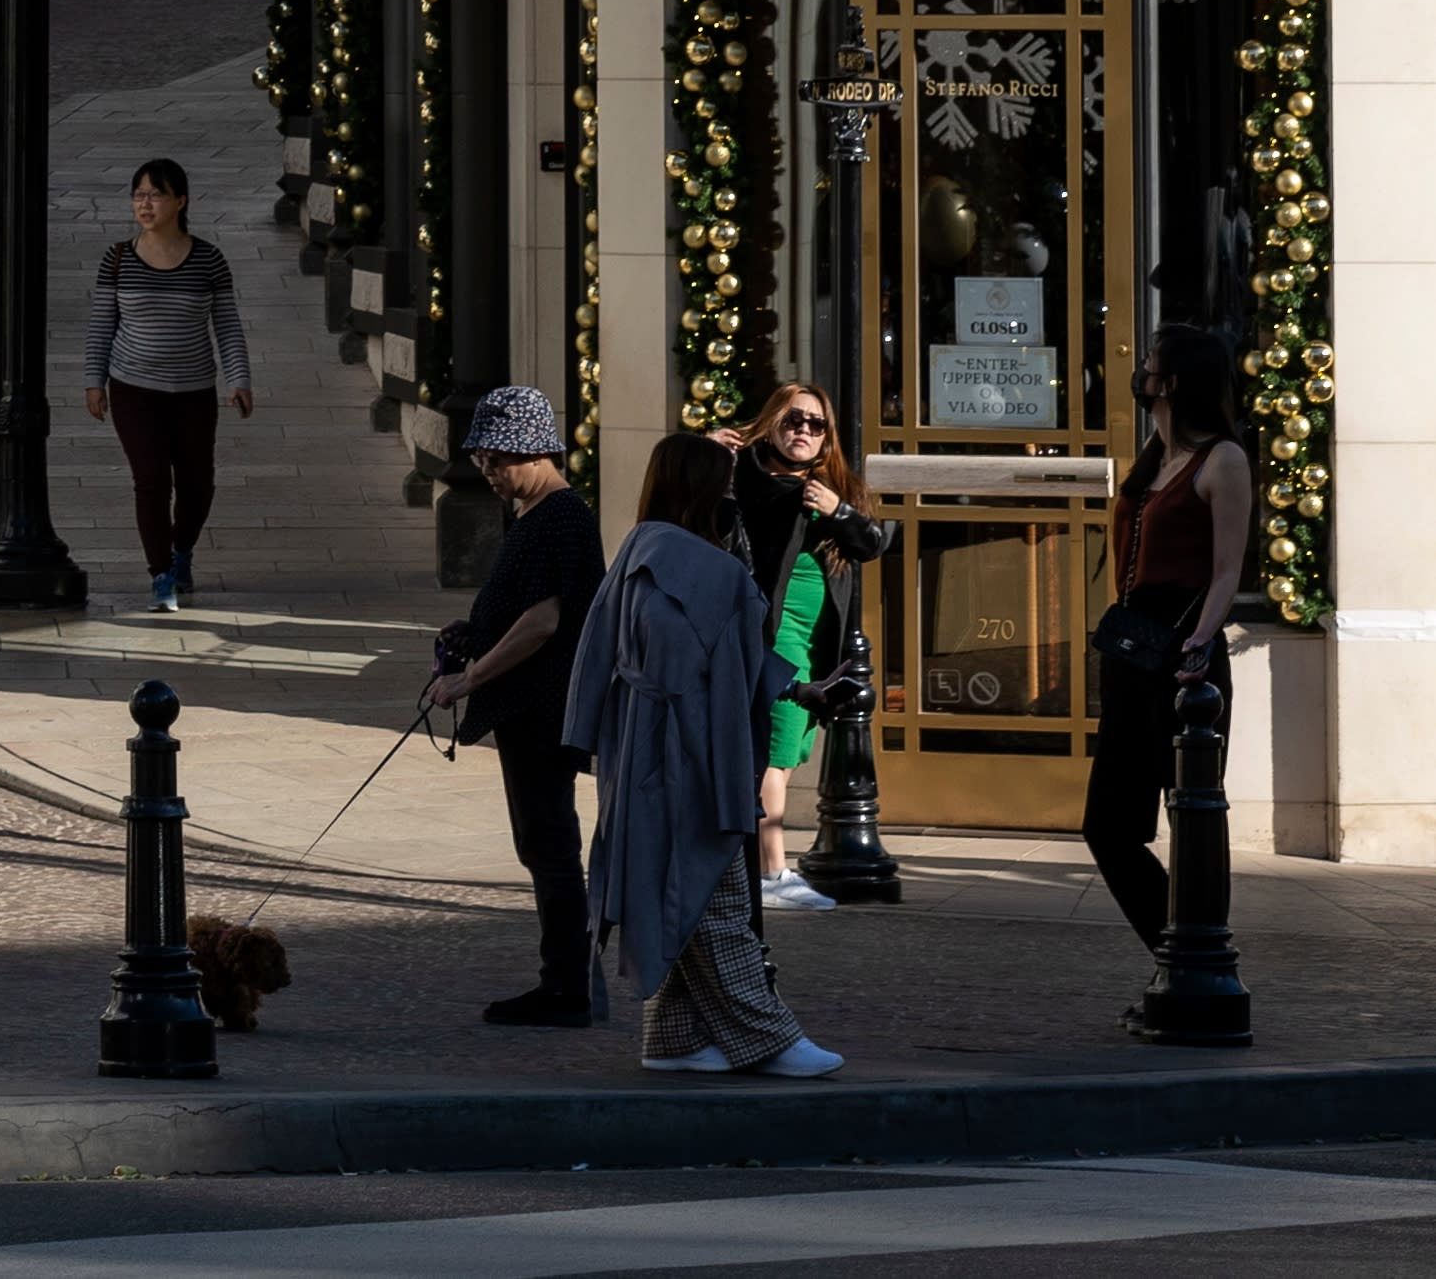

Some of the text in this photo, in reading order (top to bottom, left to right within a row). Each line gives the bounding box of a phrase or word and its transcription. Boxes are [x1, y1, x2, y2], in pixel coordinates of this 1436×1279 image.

[828, 82, 873, 101] RODEO
[970, 321, 1028, 335] CLOSED
[943, 372, 1043, 386] UPPER DOOR
[948, 402, 1038, 415] VIA RODEO
[977, 617, 1016, 640] 270
